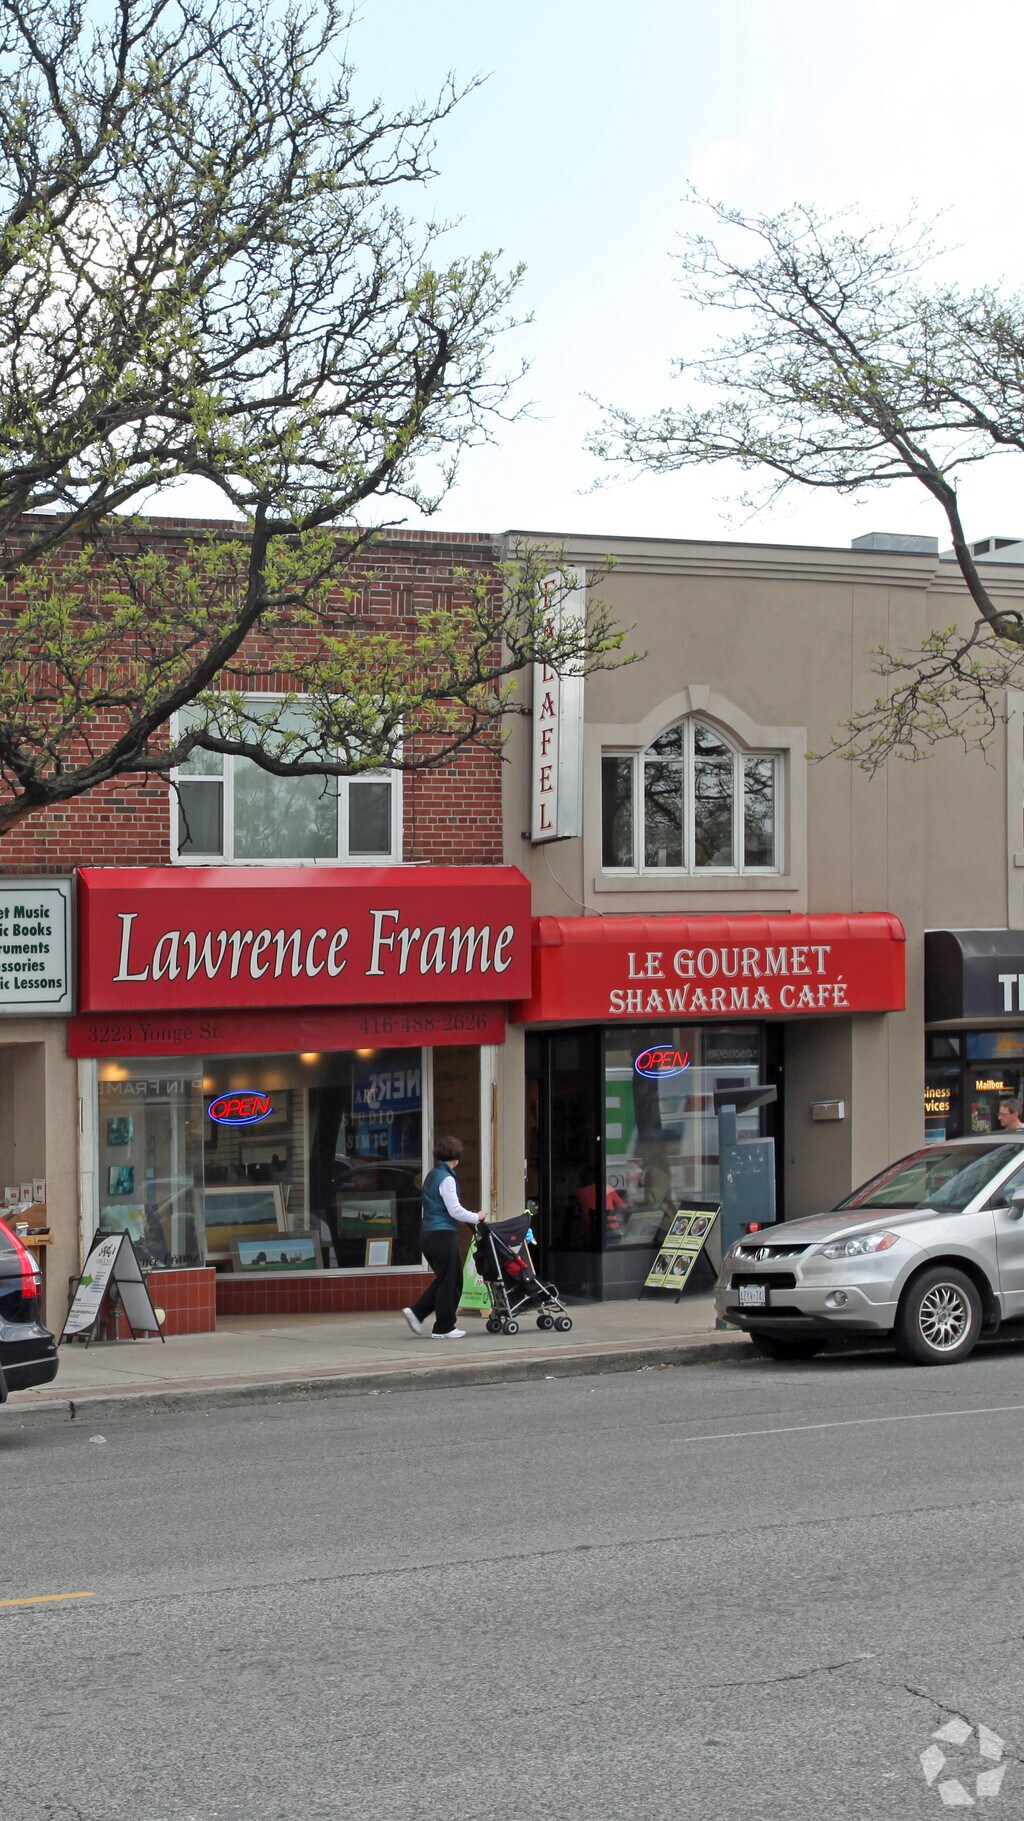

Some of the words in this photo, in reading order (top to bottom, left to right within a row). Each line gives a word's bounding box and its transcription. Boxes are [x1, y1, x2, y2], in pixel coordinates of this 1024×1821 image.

[13, 904, 50, 919] Music
[13, 922, 52, 936] Books
[112, 911, 350, 982] Lawrence
[365, 908, 515, 978] Frame
[628, 952, 665, 980] LE
[673, 946, 831, 979] GOURMET
[14, 976, 63, 990] Lessons
[608, 983, 772, 1015] SHAWARMA
[779, 975, 849, 1010] CAFÉ
[360, 1012, 487, 1034] 416-488-2626
[88, 1024, 133, 1043] 3223
[139, 1023, 193, 1044] Yonge
[199, 1022, 224, 1041] St.
[637, 1051, 689, 1069] OPEN
[976, 1080, 1004, 1089] Mailbox
[211, 1097, 271, 1118] OPEN
[342, 1110, 394, 1126] STUDIO
